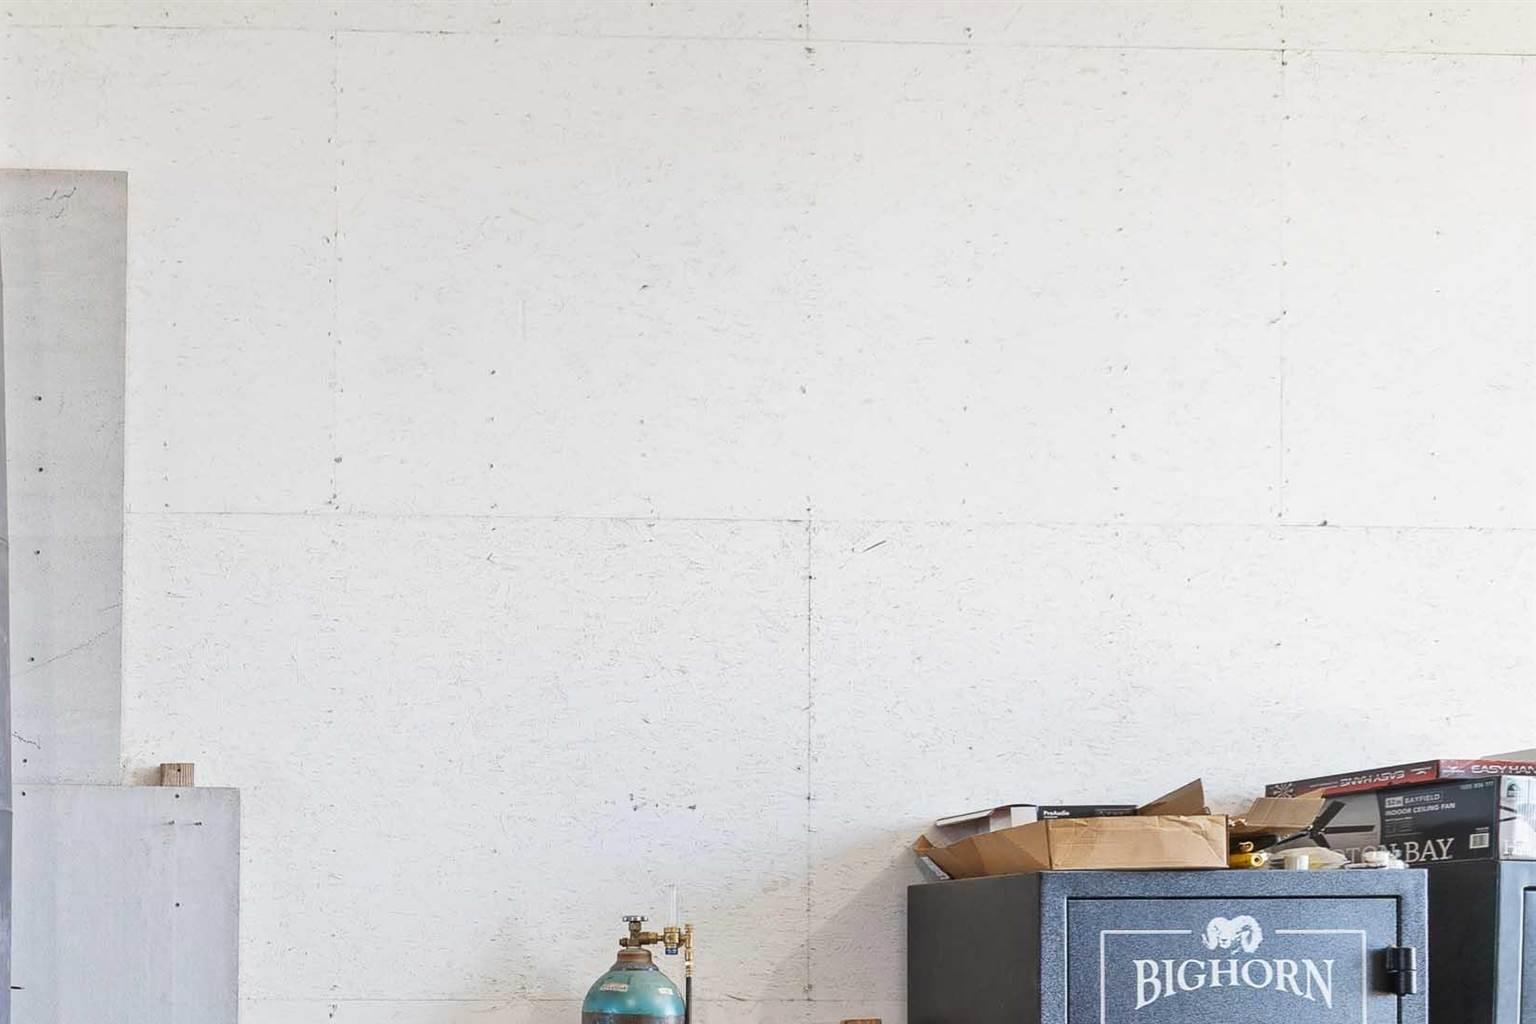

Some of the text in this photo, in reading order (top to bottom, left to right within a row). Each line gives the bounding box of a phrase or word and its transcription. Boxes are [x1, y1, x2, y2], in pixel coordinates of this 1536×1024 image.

[1472, 764, 1536, 775] EASY HAN
[1413, 804, 1439, 813] CEILING
[1441, 802, 1456, 811] FAN
[1404, 838, 1455, 864] BAY
[1133, 959, 1335, 1010] BIGHORN
